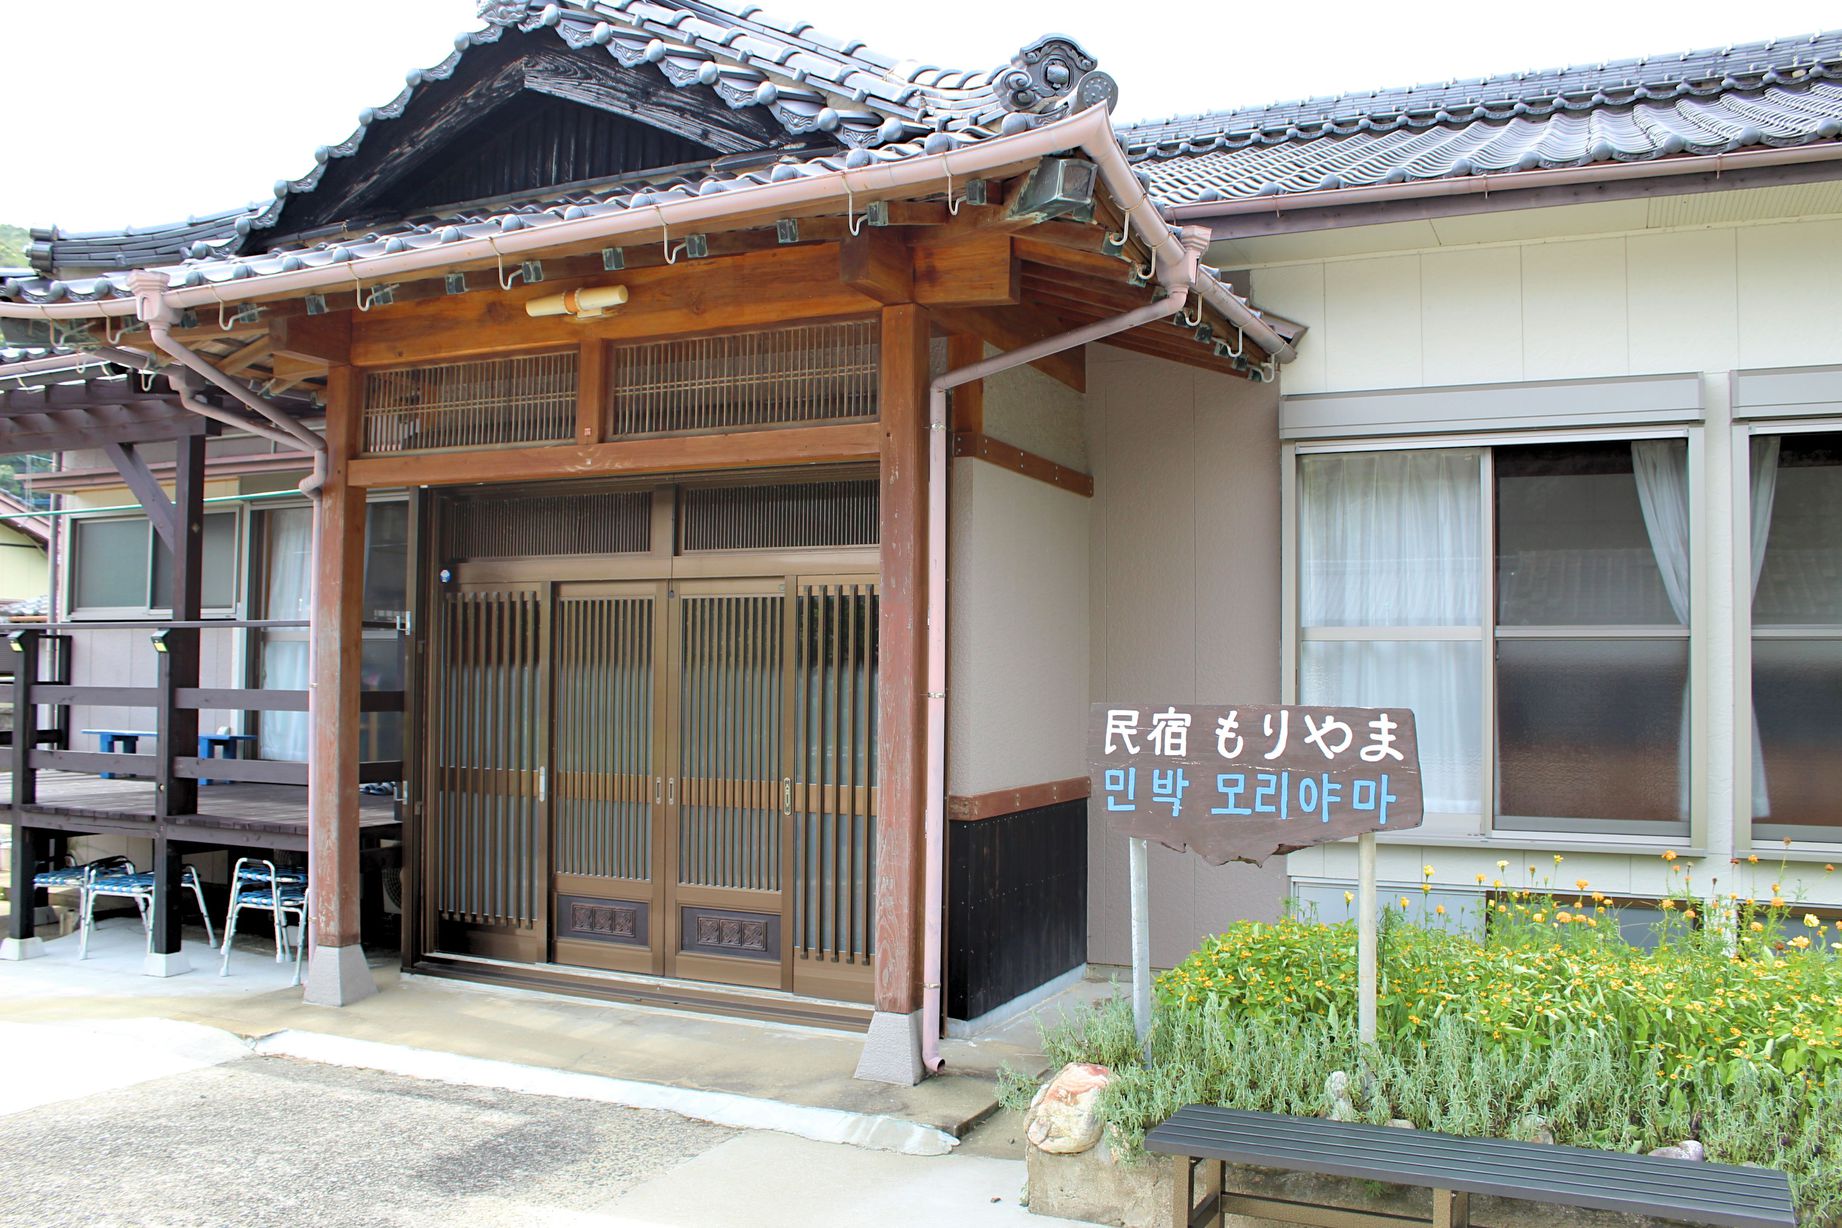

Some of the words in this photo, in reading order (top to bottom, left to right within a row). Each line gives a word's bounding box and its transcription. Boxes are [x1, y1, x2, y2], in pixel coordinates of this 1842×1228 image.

[1104, 706, 1191, 757] 民宿
[1215, 709, 1404, 762] もりやま
[1104, 767, 1189, 817] 민박
[1210, 771, 1397, 825] 모리야마
